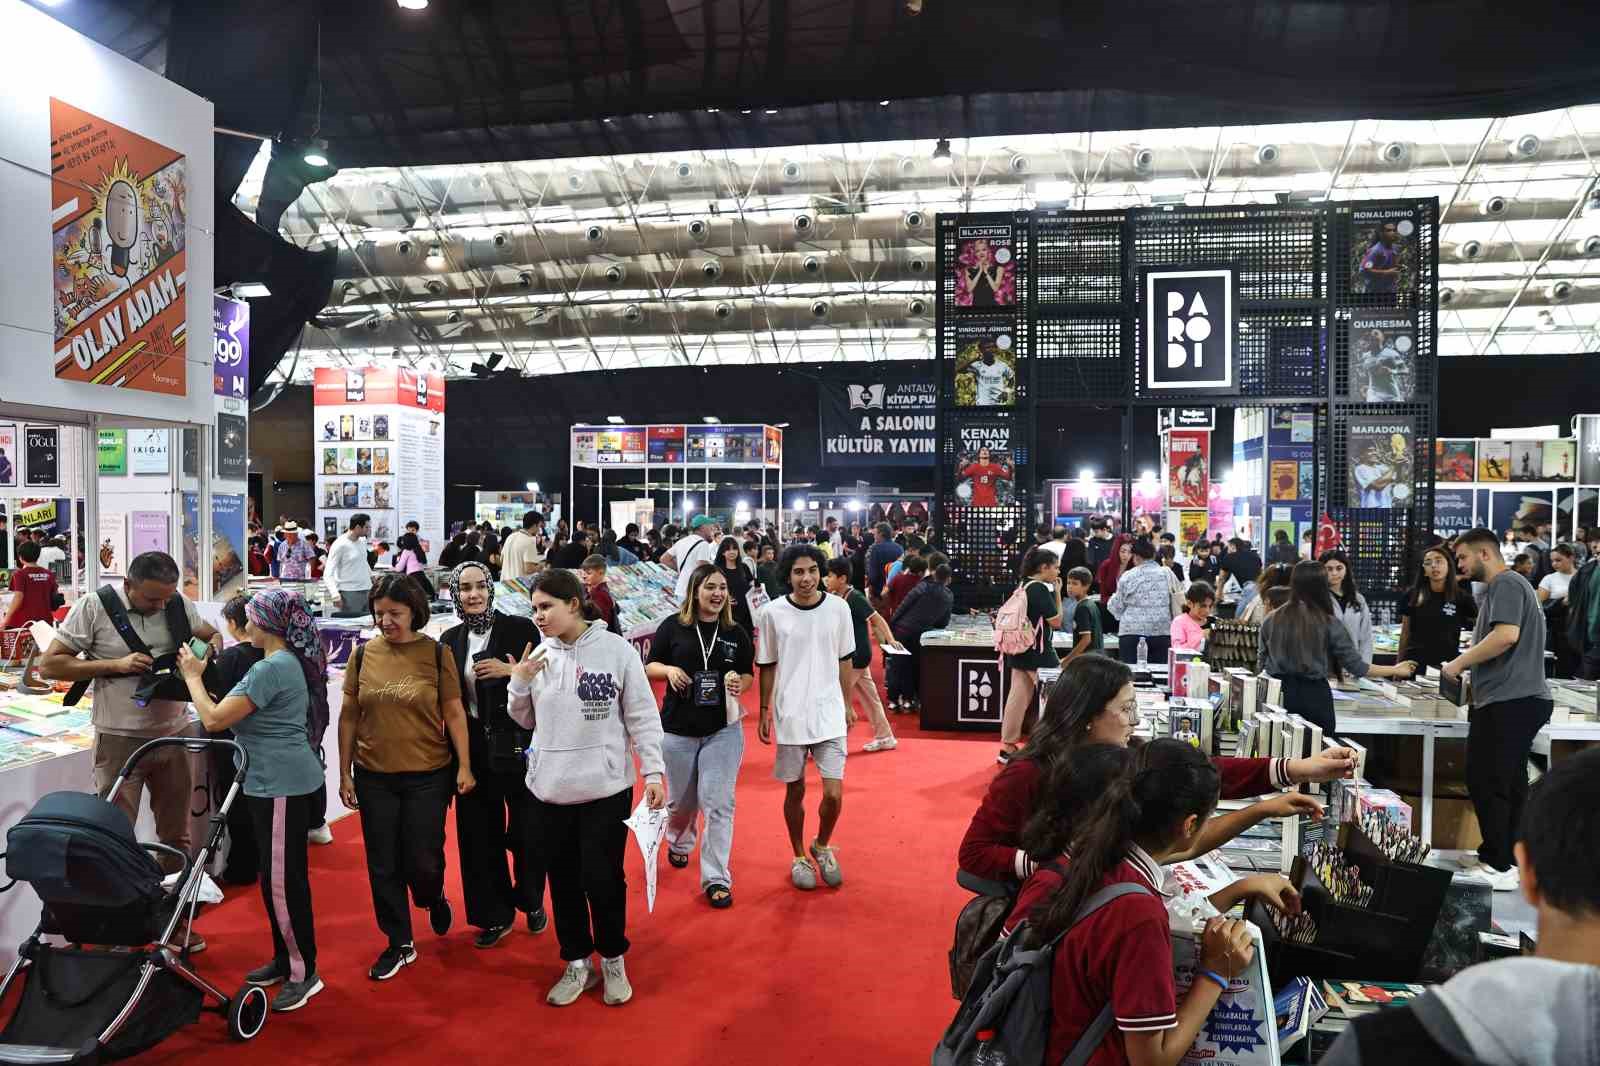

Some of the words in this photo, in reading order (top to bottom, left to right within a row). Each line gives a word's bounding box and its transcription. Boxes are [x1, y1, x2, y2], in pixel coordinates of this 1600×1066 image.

[1353, 210, 1414, 219] RONALDINHO
[72, 305, 126, 370] OLAY
[125, 268, 179, 333] ADAM
[1353, 320, 1413, 329] QUARESMA
[214, 333, 242, 366] igo
[887, 393, 917, 404] KİTAP
[860, 416, 871, 431] A
[876, 416, 936, 431] SALONU
[1351, 425, 1411, 434] MARADONA
[960, 428, 1010, 439] KENAN
[827, 434, 884, 453] KÜLTÜR
[889, 439, 936, 453] YAYIN
[23, 508, 52, 524] NLARI
